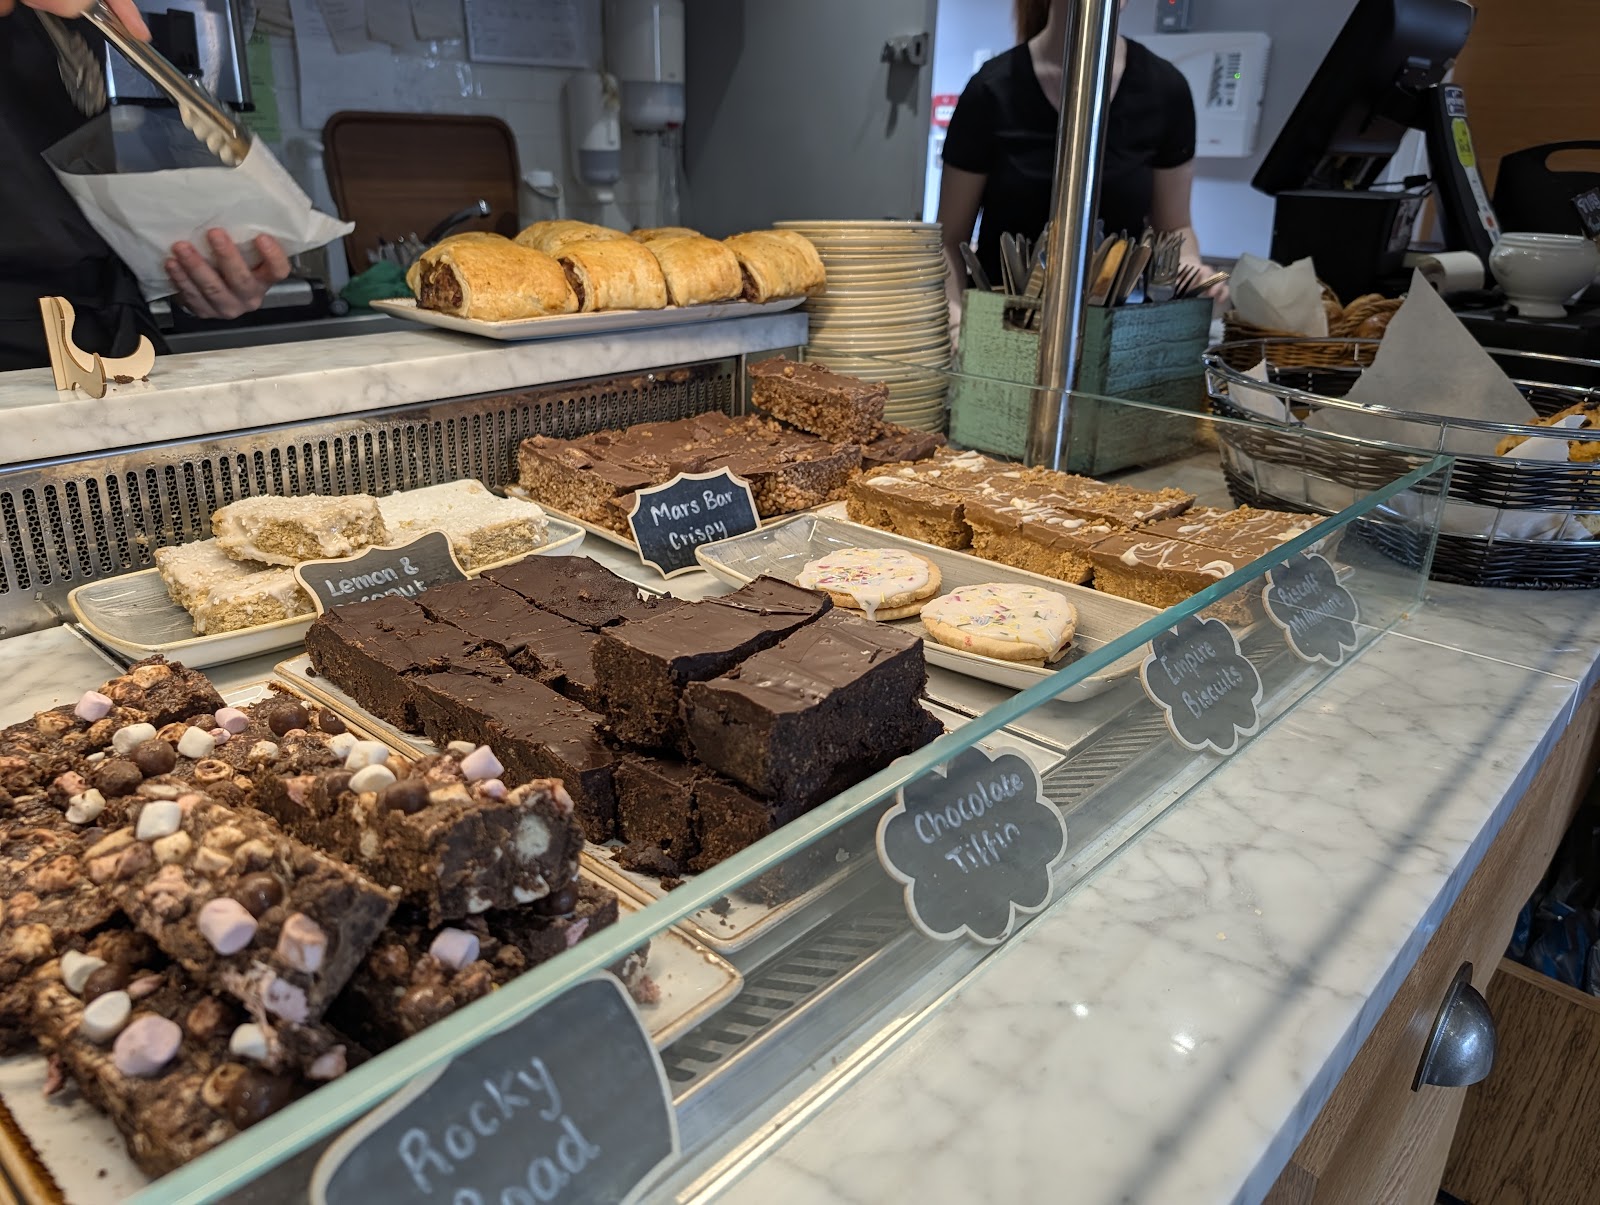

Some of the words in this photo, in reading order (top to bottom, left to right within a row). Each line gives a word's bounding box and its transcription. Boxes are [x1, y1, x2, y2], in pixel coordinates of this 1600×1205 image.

[650, 500, 700, 526] Mars
[703, 490, 733, 510] Bar
[669, 520, 728, 550] Crispy
[325, 567, 399, 597] Lemon
[400, 556, 420, 576] &
[335, 579, 428, 607] conut
[1277, 572, 1320, 605] Biscoff
[1160, 641, 1217, 686] Empire
[1182, 665, 1243, 719] Biscuits
[914, 773, 1024, 844] Chocolate
[944, 822, 1021, 873] Tiffin
[399, 1056, 562, 1194] Rocky
[453, 1115, 601, 1205] ad
